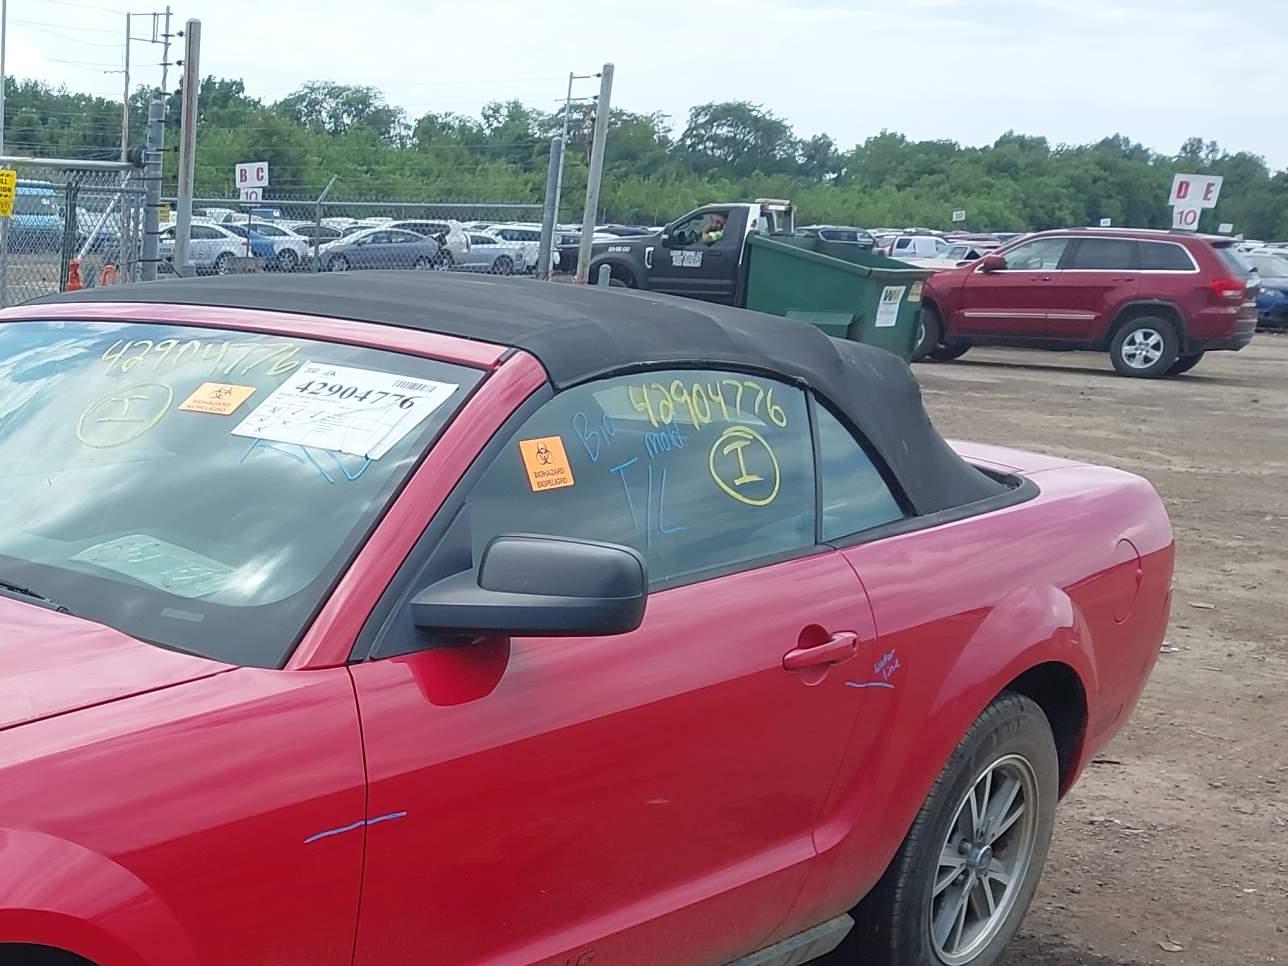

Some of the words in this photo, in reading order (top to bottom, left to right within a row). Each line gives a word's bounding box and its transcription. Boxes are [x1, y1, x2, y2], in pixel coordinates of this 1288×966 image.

[239, 168, 248, 183] B
[256, 167, 264, 181] C
[245, 190, 258, 200] 10
[1176, 181, 1190, 199] D
[1202, 182, 1215, 201] E
[1177, 209, 1197, 225] 10
[100, 338, 304, 377] 42904776
[295, 379, 425, 410] 42904776
[628, 379, 788, 430] 42904776
[533, 467, 566, 479] BIOHAZARD
[536, 477, 568, 489] BIOPELIGRO
